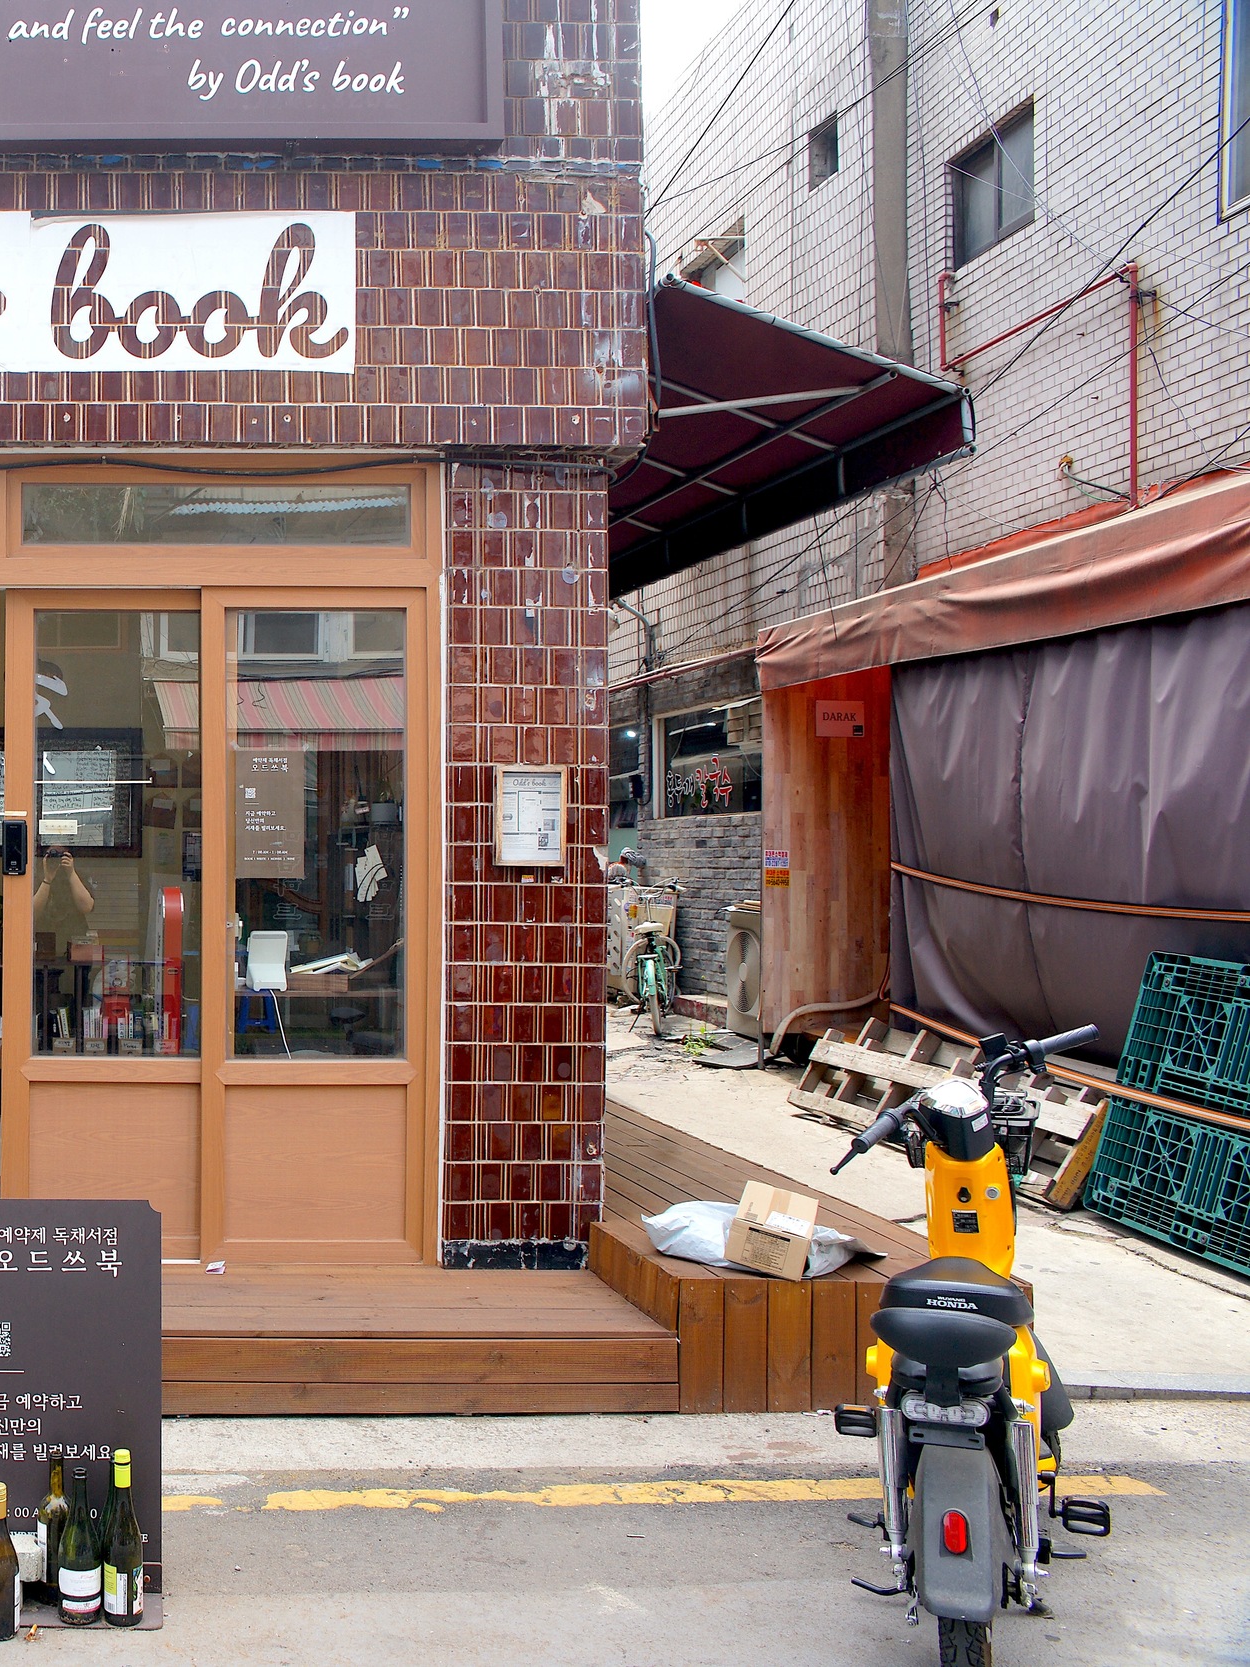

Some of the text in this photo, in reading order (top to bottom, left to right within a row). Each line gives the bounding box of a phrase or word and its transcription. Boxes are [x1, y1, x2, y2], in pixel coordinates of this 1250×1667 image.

[8, 9, 75, 40] and
[81, 7, 143, 44] feel
[149, 8, 205, 39] the
[187, 59, 406, 100] by Odd’s book
[52, 223, 350, 361] book
[822, 711, 857, 722] DARAK
[52, 1227, 119, 1246] 독채서점
[926, 1298, 978, 1309] HONDA
[15, 1392, 83, 1412] 예약하고
